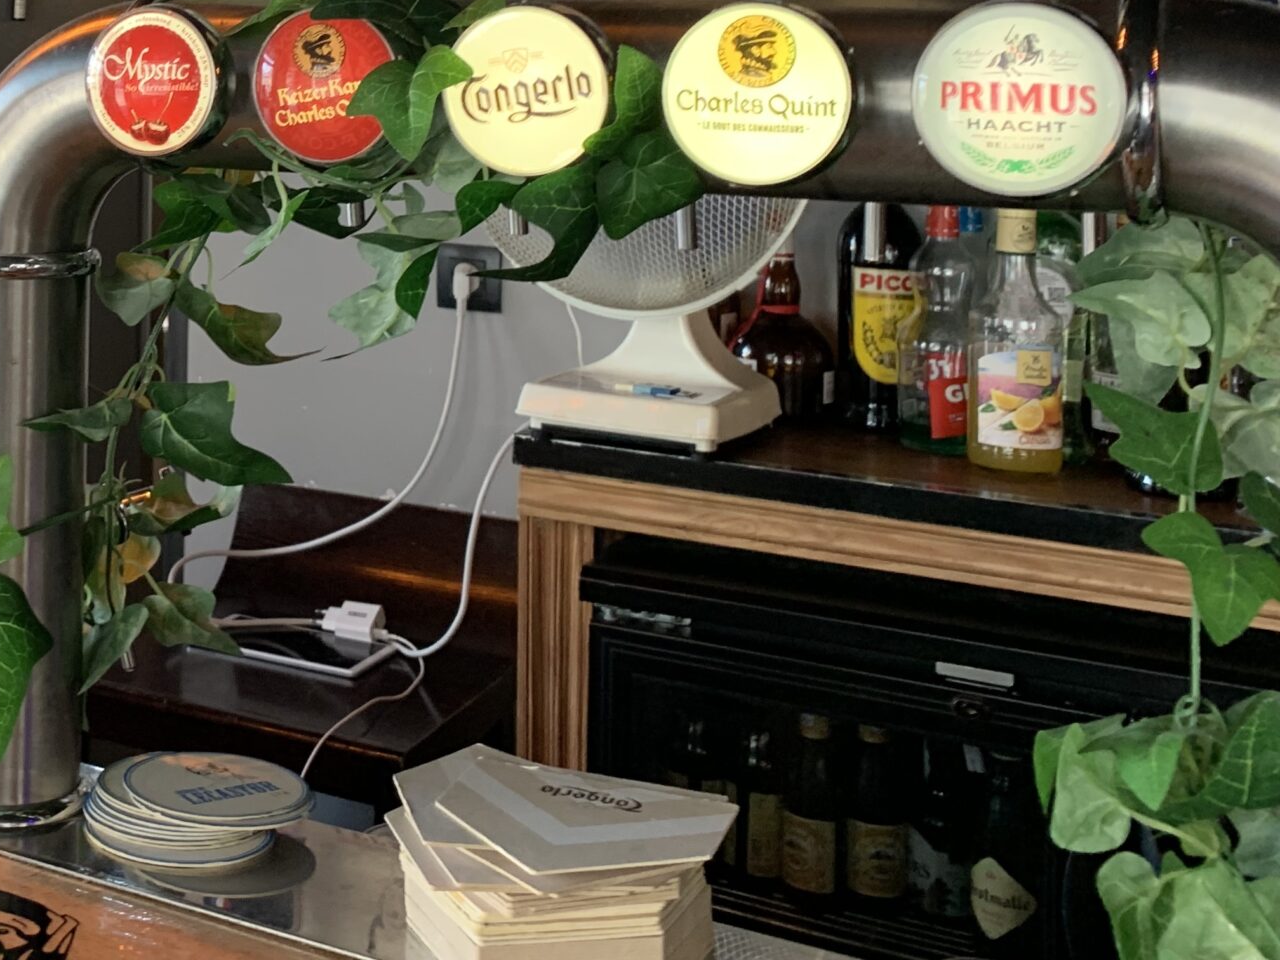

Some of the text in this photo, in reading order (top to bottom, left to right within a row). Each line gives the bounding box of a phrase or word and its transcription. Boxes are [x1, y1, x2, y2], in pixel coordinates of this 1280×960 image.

[103, 46, 191, 93] Mystic
[328, 77, 361, 98] Kar
[461, 64, 592, 123] Tongerlo
[940, 80, 1098, 117] PRIMUS
[275, 103, 336, 127] Charles
[676, 88, 837, 120] Charles Quint
[967, 117, 1067, 133] HAACHT
[540, 784, 643, 813] Tongerlo
